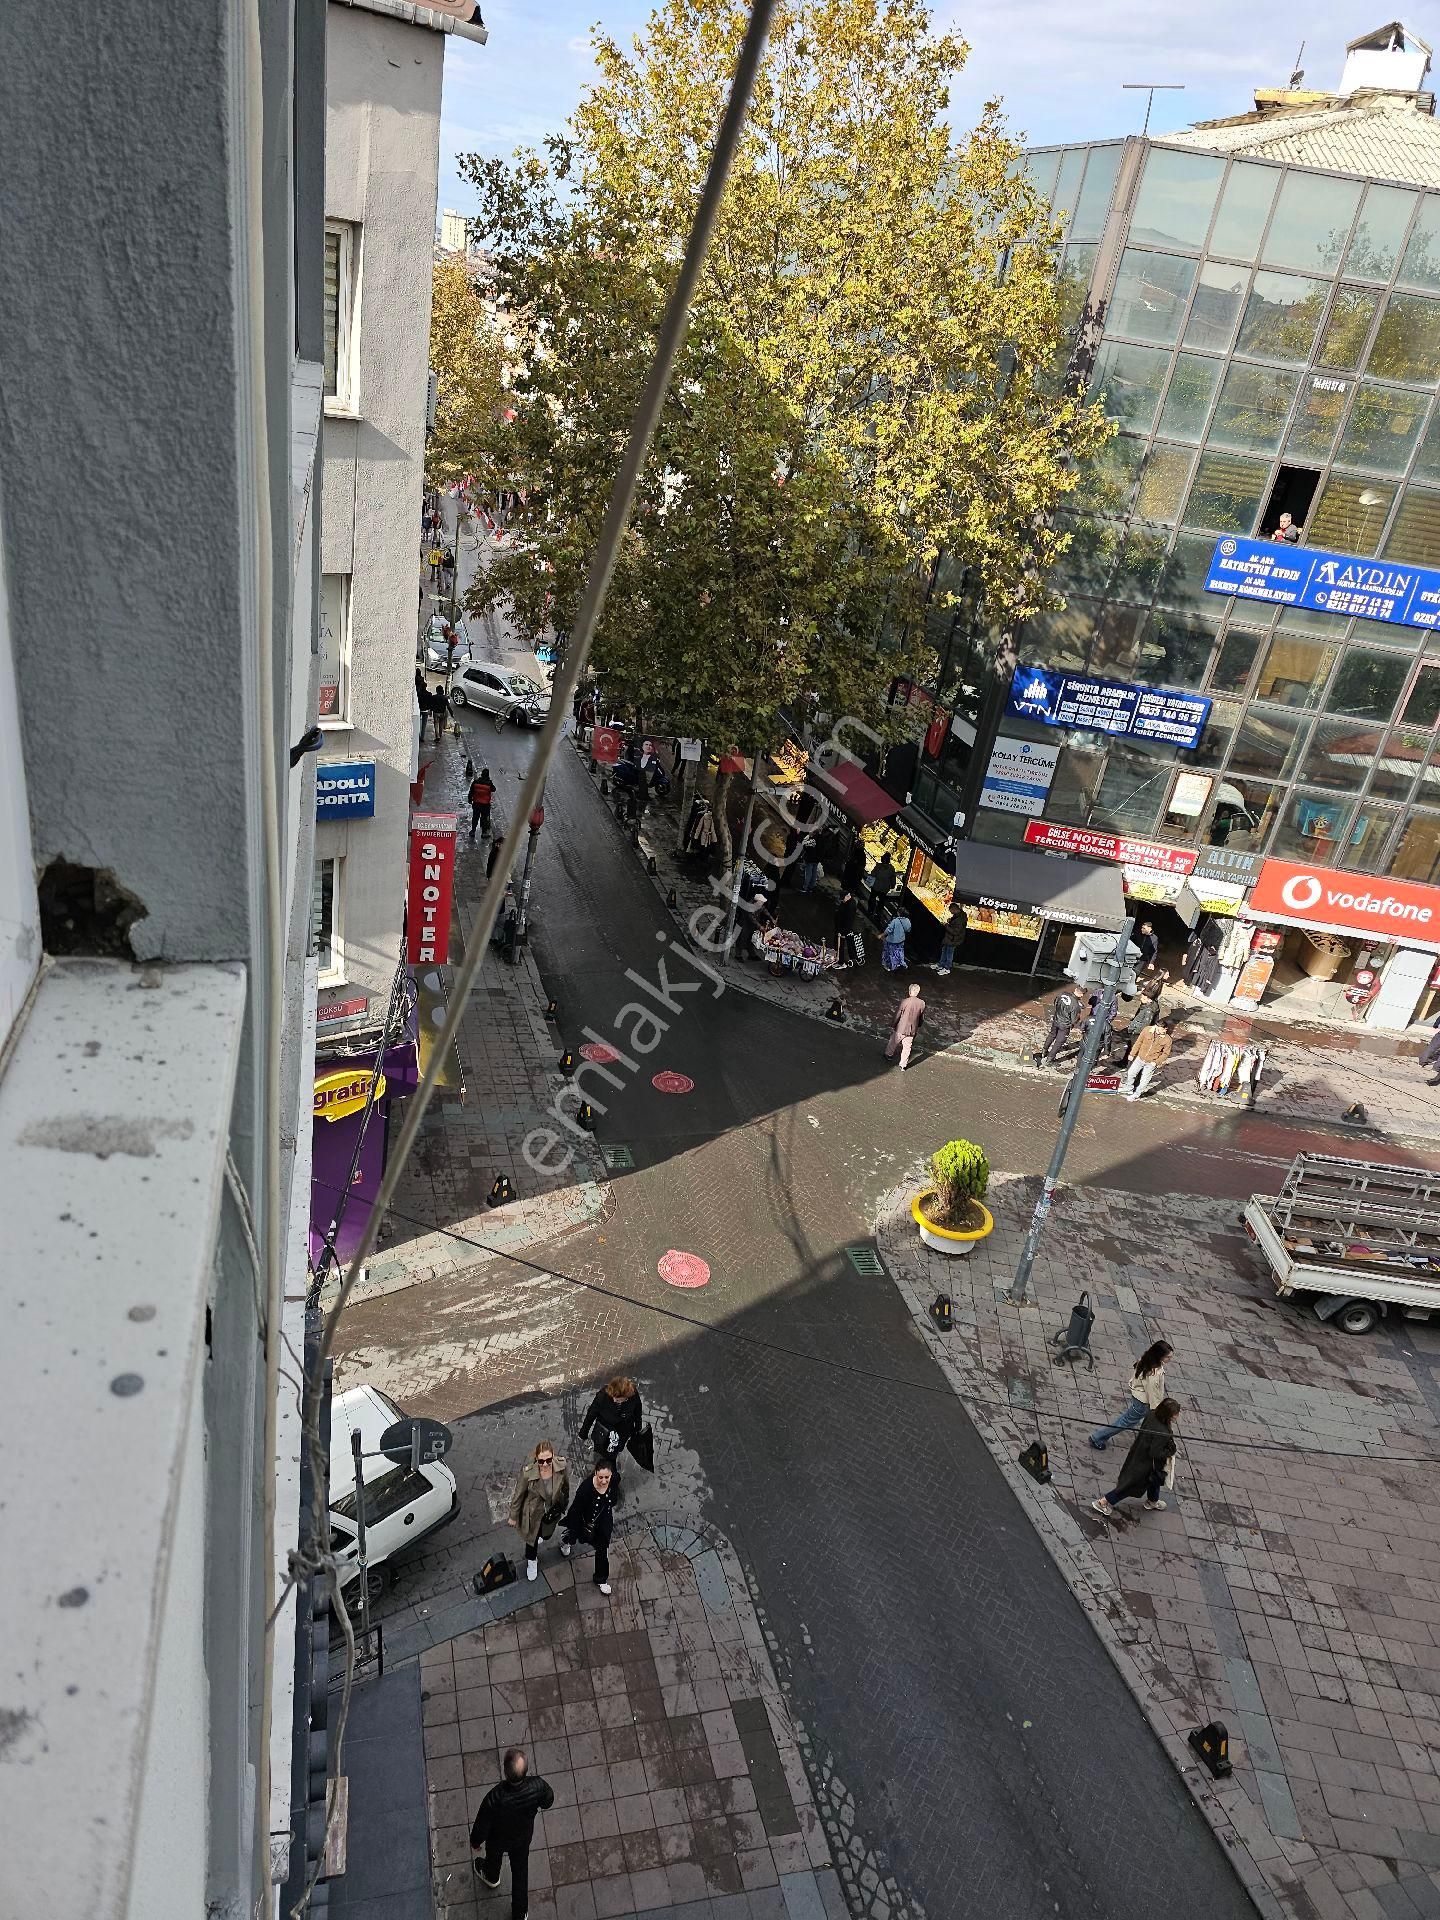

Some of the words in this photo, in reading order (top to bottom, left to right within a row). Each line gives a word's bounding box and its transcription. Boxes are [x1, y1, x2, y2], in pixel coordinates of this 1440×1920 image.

[1340, 566, 1412, 590] AYDIN
[1330, 590, 1351, 601] 0212
[1014, 700, 1051, 716] VTN
[992, 751, 1018, 762] KOLAY
[1020, 756, 1055, 768] TERCÜME
[1035, 836, 1078, 850] TERCÜME
[1072, 832, 1116, 848] NOTER
[1206, 851, 1254, 870] ALTIN
[1327, 890, 1433, 922] vodafone
